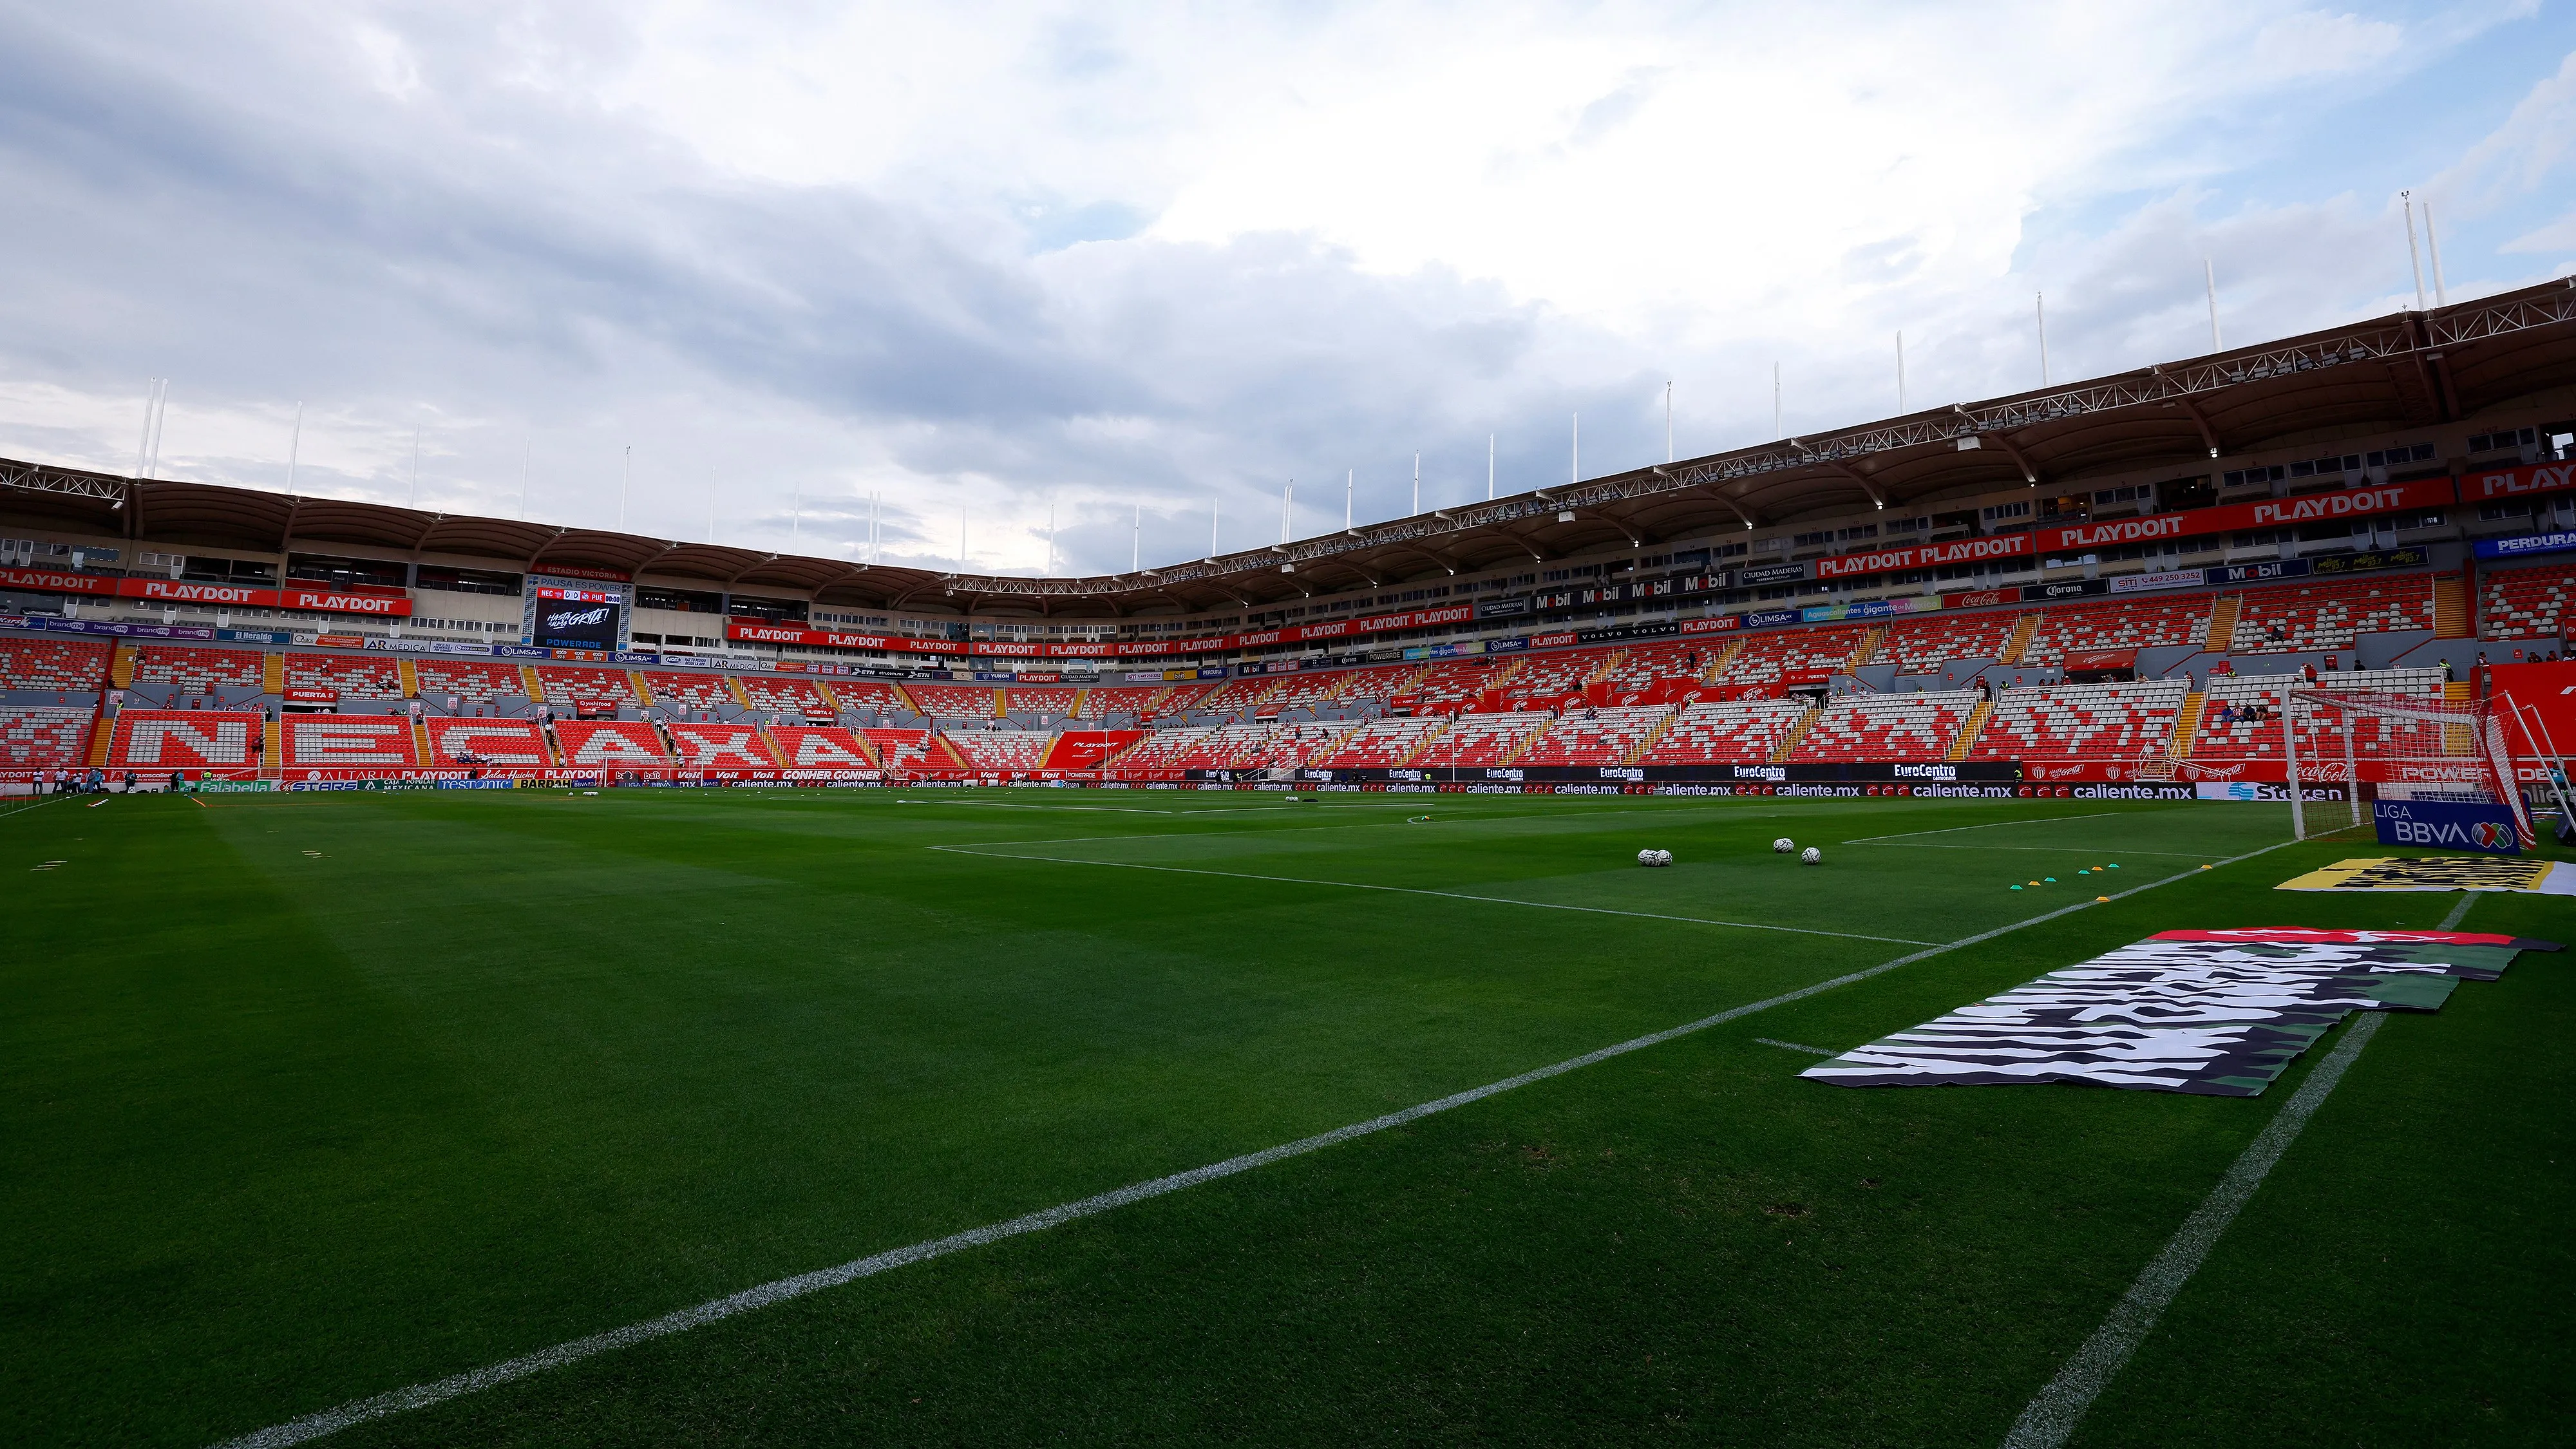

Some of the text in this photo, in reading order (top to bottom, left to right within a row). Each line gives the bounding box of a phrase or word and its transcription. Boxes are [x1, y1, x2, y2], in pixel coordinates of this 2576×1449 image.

[2255, 488, 2403, 523] PLAYDOIT
[2061, 516, 2184, 547] PLAYDOIT
[2497, 533, 2576, 551] PERDURA
[1920, 536, 2025, 563] PLAYDOIT
[1821, 551, 1912, 576] PLAYDOIT
[547, 567, 617, 579] ESTADIO VICTORIA
[1772, 566, 1803, 574] MADERAS
[2229, 564, 2282, 579] Mobil
[0, 568, 97, 589] PLAYDOIT
[541, 578, 573, 587] PAUSA
[1685, 573, 1726, 591] Mobil
[146, 582, 253, 601] PLAYDOIT
[1583, 587, 1620, 603] Mobil
[1633, 580, 1671, 598] Mobil
[2046, 583, 2082, 596] Corona
[299, 594, 393, 611] PLAYDOIT
[1501, 600, 1523, 609] MADERAS
[1537, 593, 1570, 609] Mobil
[1808, 600, 1937, 618] Aguascalientes gigante México
[1416, 607, 1469, 624] PLAYDOIT
[50, 620, 84, 630] brandme
[94, 624, 128, 632] brandme
[1360, 615, 1409, 631] PLAYDOIT
[1684, 618, 1733, 631] PLAYDOIT
[243, 632, 272, 640] Heraldo
[740, 627, 801, 641] PLAYDOIT
[1302, 623, 1346, 638] PLAYDOIT
[1582, 631, 1622, 639] VOLVO
[547, 639, 601, 649] POWERADE
[828, 634, 886, 647] PLAYDOIT
[1180, 639, 1223, 651] PLAYDOIT
[1240, 632, 1279, 646] PLAYDOIT
[1531, 634, 1573, 646] PLAYDOIT
[367, 639, 426, 652] AR MÉDICA
[910, 641, 958, 651] PLAYDOIT
[979, 644, 1036, 654] PLAYDOIT
[1051, 645, 1105, 654] PLAYDOIT
[1119, 643, 1169, 654] PLAYDOIT
[1439, 647, 1459, 656] gigante
[1369, 652, 1401, 660] POWERADE
[730, 661, 756, 670] MÉDICA
[1622, 692, 1639, 706] Victoria
[1743, 687, 1763, 700] Victoria
[323, 770, 397, 780] ALTARIA
[402, 771, 470, 780] PLAYDOIT
[545, 770, 605, 779] PLAYDOIT
[782, 770, 832, 780] GONHER
[833, 770, 881, 780] GONHER
[1305, 770, 1332, 779] EuroCentro
[1389, 770, 1421, 779] EuroCentro
[1486, 768, 1524, 778] EuroCentro
[1600, 767, 1643, 778] EuroCentro
[1734, 766, 1786, 777] EuroCentro
[1895, 764, 1956, 777] EuroCentro
[200, 781, 268, 793] Falabella
[292, 781, 357, 791] STARS
[732, 779, 793, 788] caliente.mx
[827, 779, 882, 788] caliente.mx
[1197, 782, 1233, 791] caliente.mx
[1254, 782, 1293, 791] caliente.mx
[1316, 782, 1360, 793] caliente.mx
[1387, 782, 1435, 793] caliente.mx
[1466, 782, 1522, 795] caliente.mx
[1555, 782, 1619, 795] caliente.mx
[1776, 783, 1859, 797] caliente.mx
[1913, 783, 2012, 799] caliente.mx
[2074, 784, 2193, 800] caliente.mx
[2374, 804, 2412, 820] LIGA
[2394, 821, 2469, 844] BBVA
